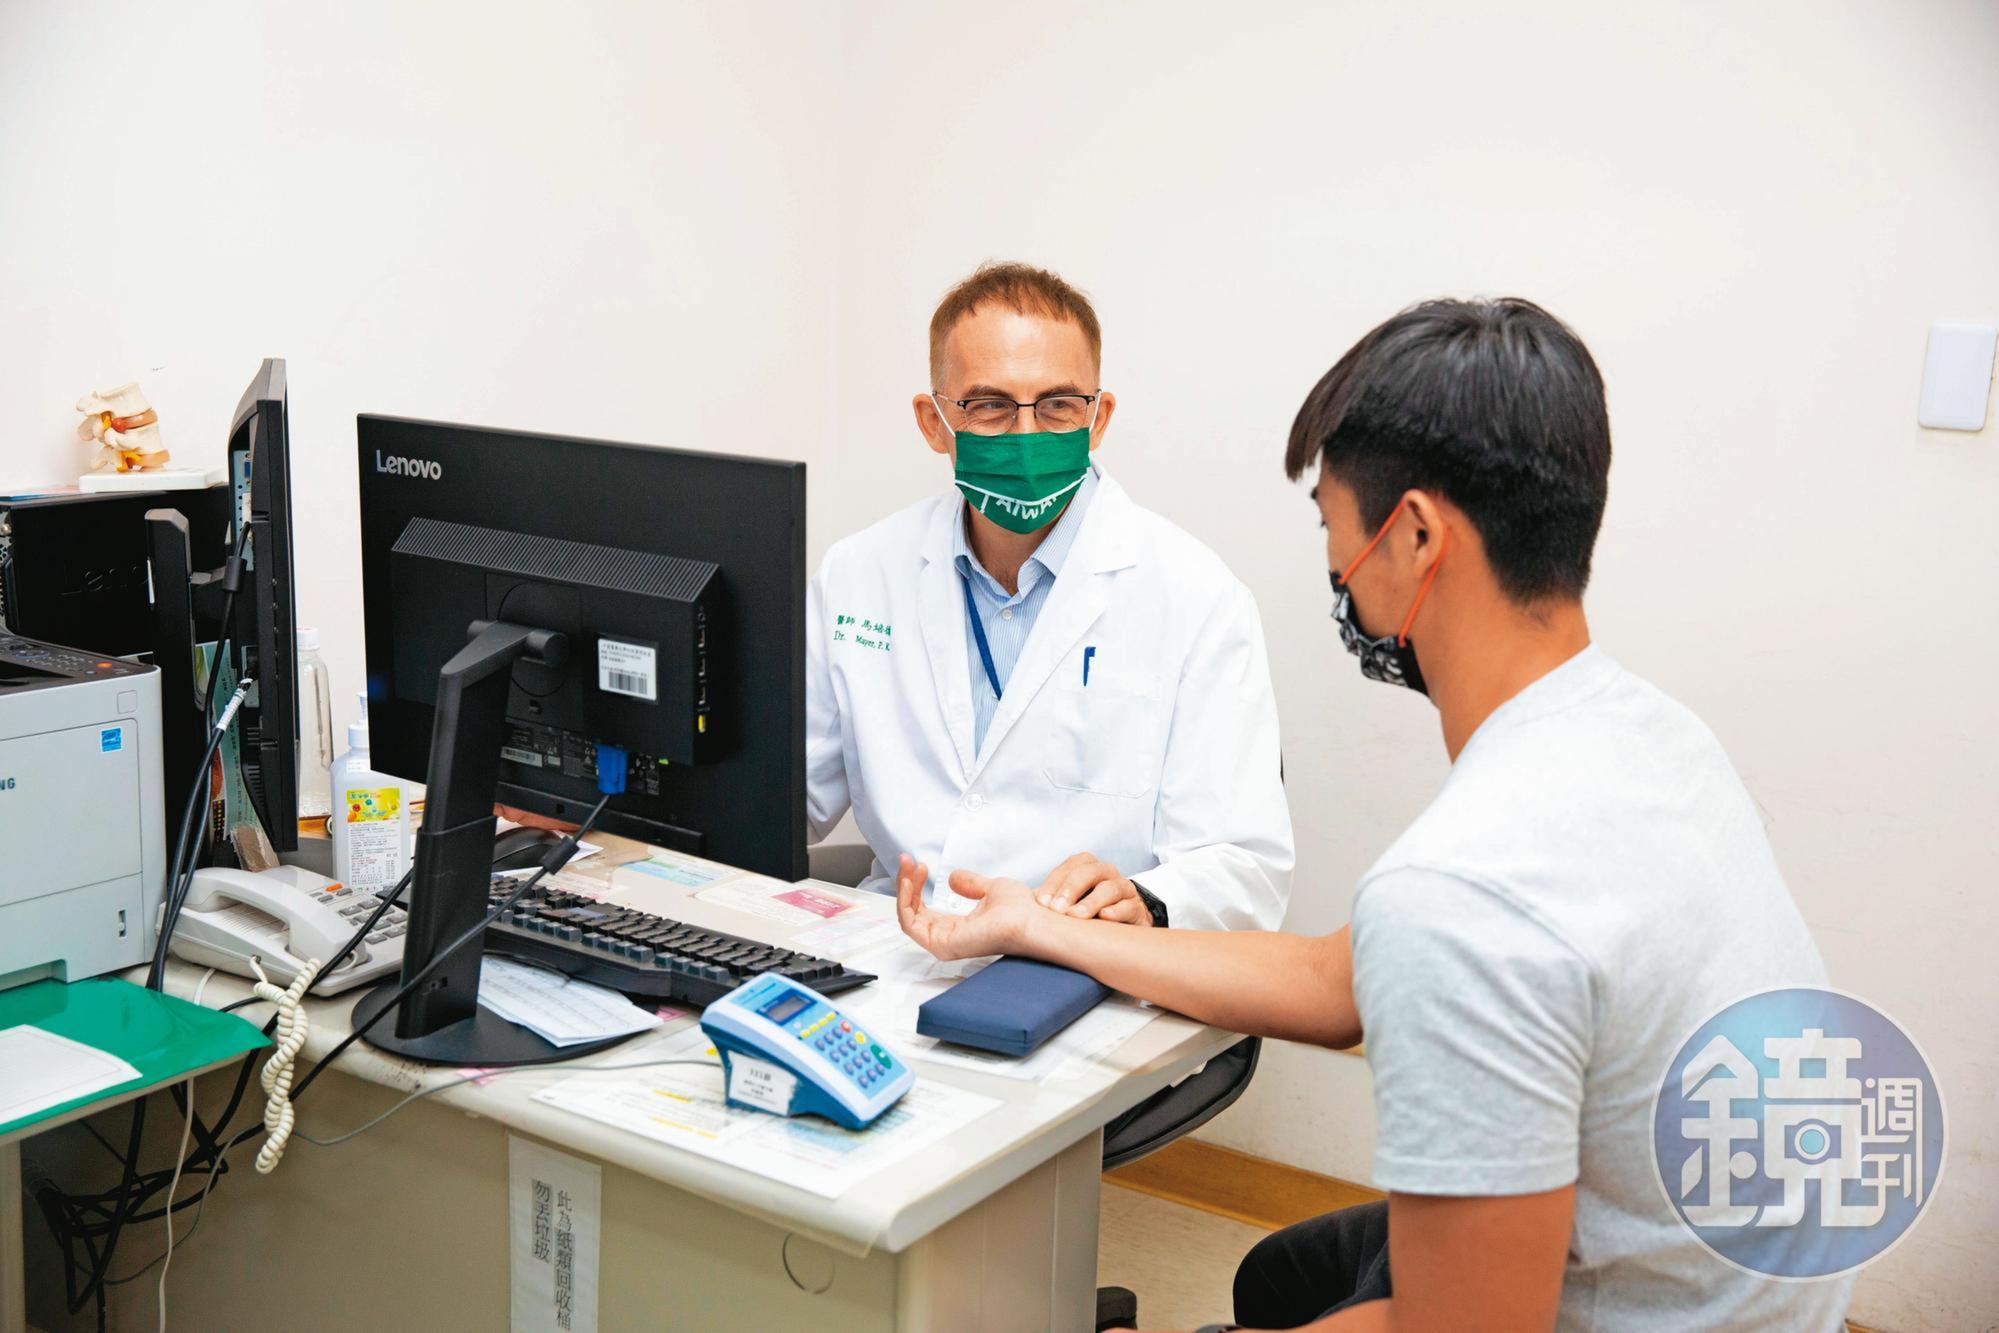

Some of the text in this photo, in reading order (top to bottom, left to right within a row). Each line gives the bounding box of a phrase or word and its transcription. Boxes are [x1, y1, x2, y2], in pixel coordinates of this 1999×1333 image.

[376, 449, 442, 480] Lenovo
[980, 494, 1057, 519] TAIWA
[833, 630, 847, 641] Dr.
[533, 1180, 552, 1264] 勿丟垃圾
[556, 1189, 573, 1332] 此為紙類回收桶
